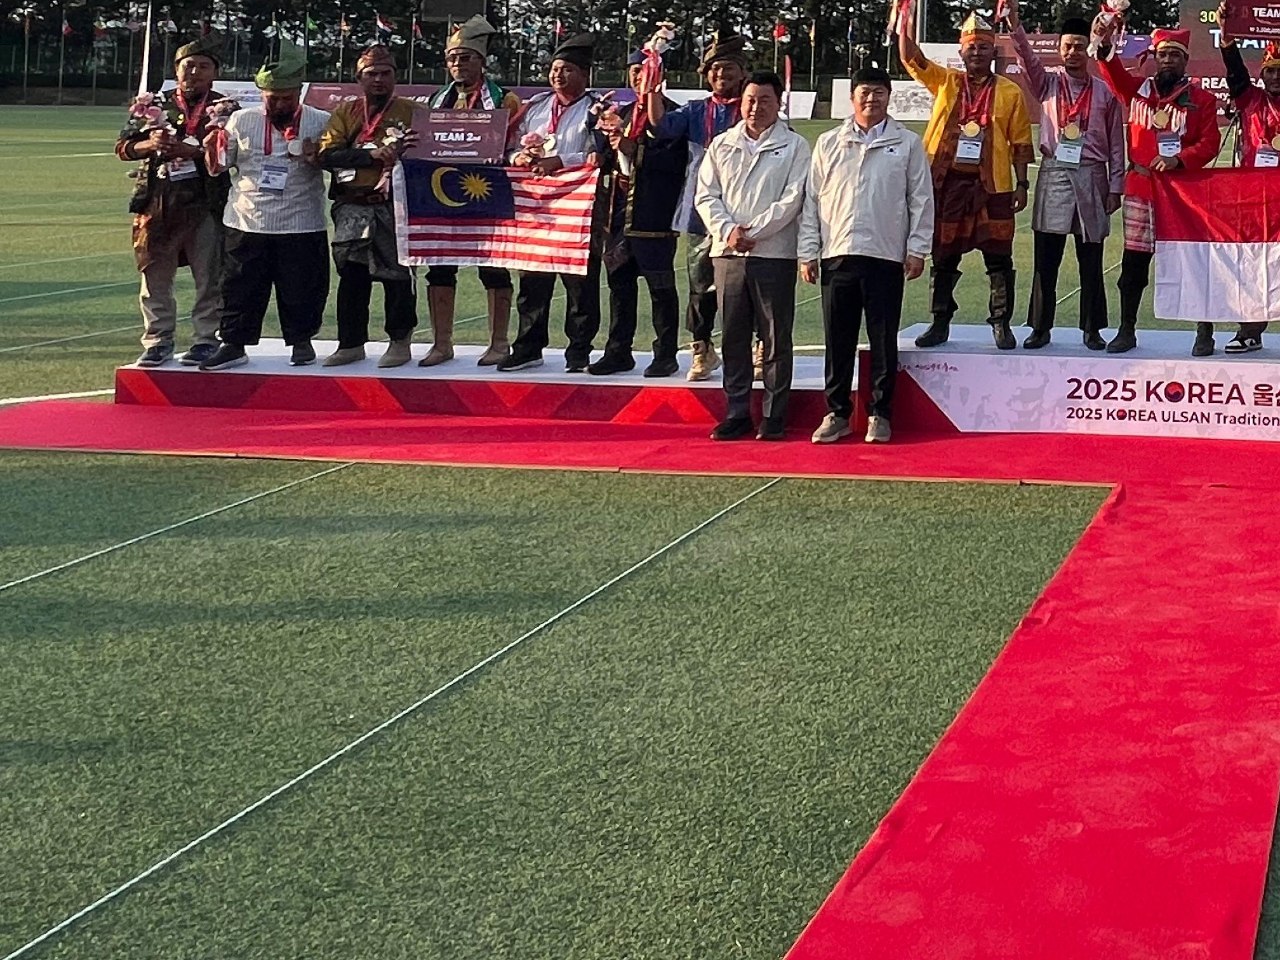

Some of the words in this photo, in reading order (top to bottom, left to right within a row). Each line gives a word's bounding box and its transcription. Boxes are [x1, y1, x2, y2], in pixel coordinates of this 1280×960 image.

[1200, 11, 1216, 23] 30
[433, 132, 465, 141] TEAM
[466, 132, 482, 142] 2nd
[1066, 378, 1137, 402] 2025
[1145, 380, 1246, 405] KOREA
[1066, 407, 1103, 420] 2025
[1106, 409, 1158, 422] KOREA
[1161, 411, 1211, 424] ULSAN
